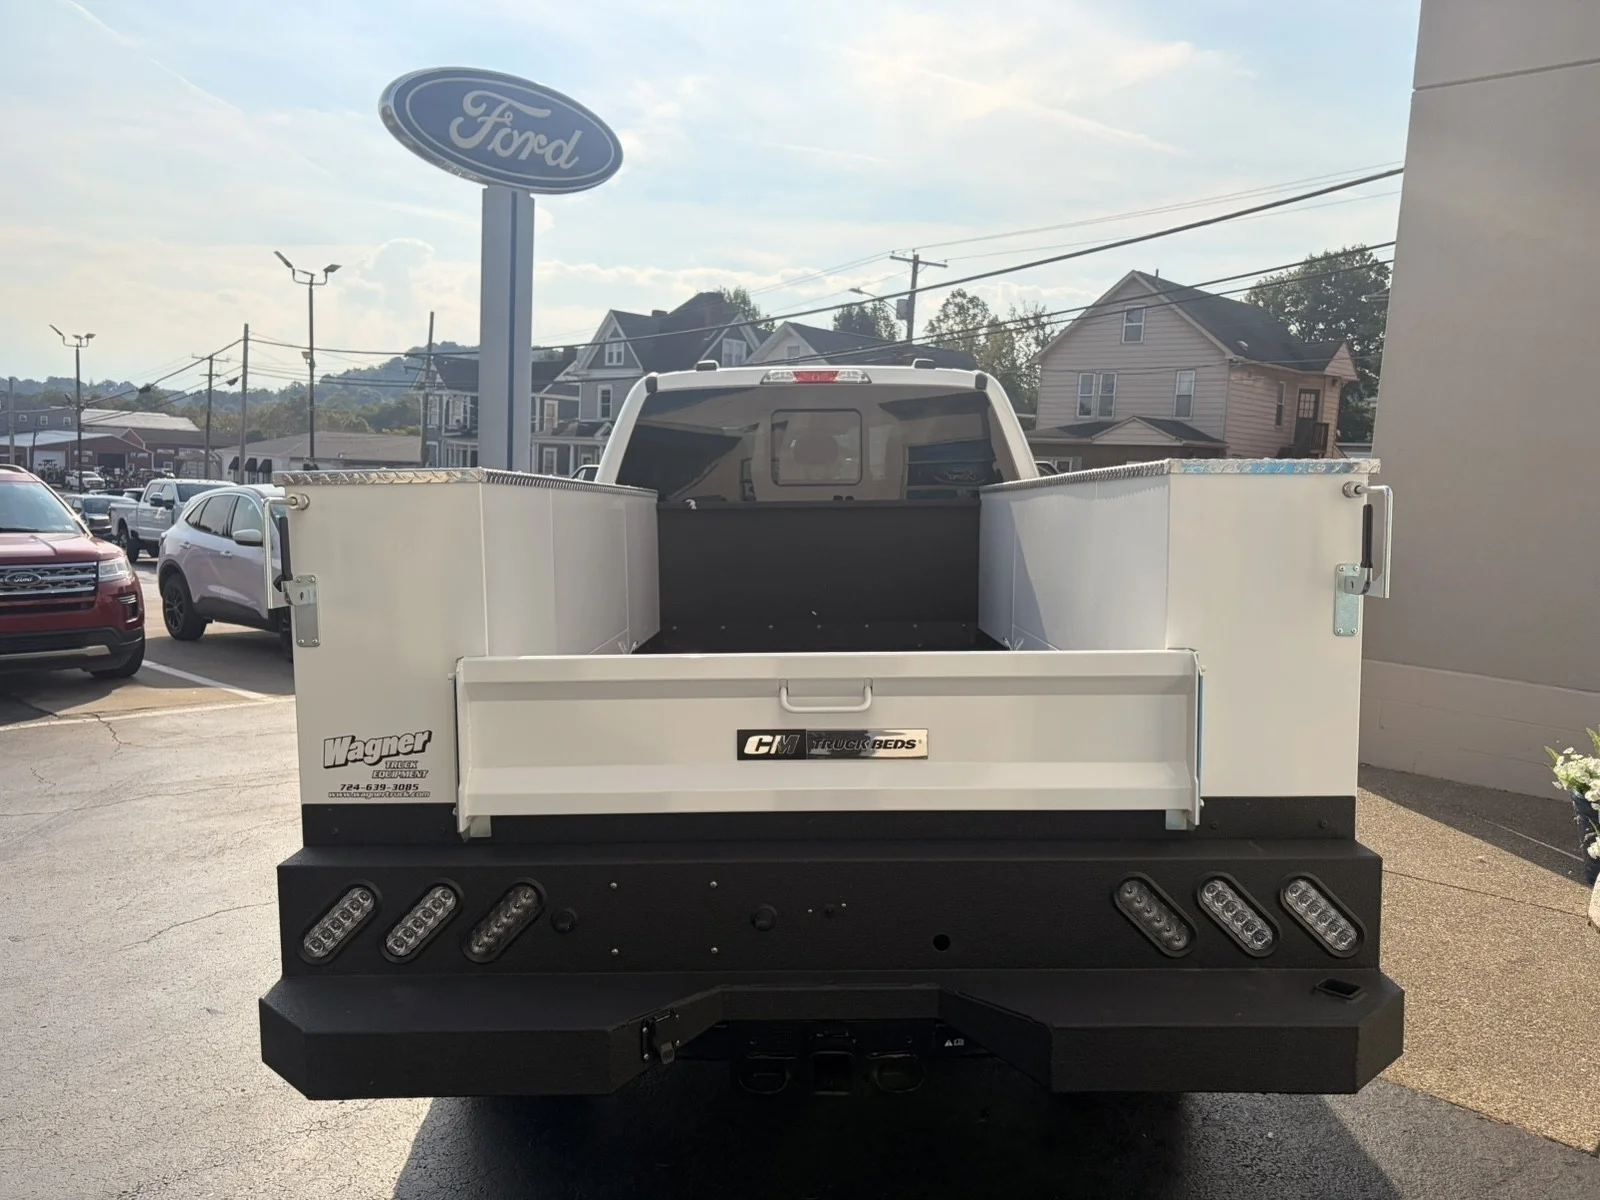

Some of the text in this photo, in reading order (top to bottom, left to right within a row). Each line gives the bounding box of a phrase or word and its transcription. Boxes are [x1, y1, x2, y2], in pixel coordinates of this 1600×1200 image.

[450, 90, 583, 170] Ford
[323, 730, 432, 769] Wagner
[743, 735, 917, 754] CM TRUCK BEDS
[385, 760, 418, 769] TRUCK
[372, 770, 429, 779] EQUIPMENT
